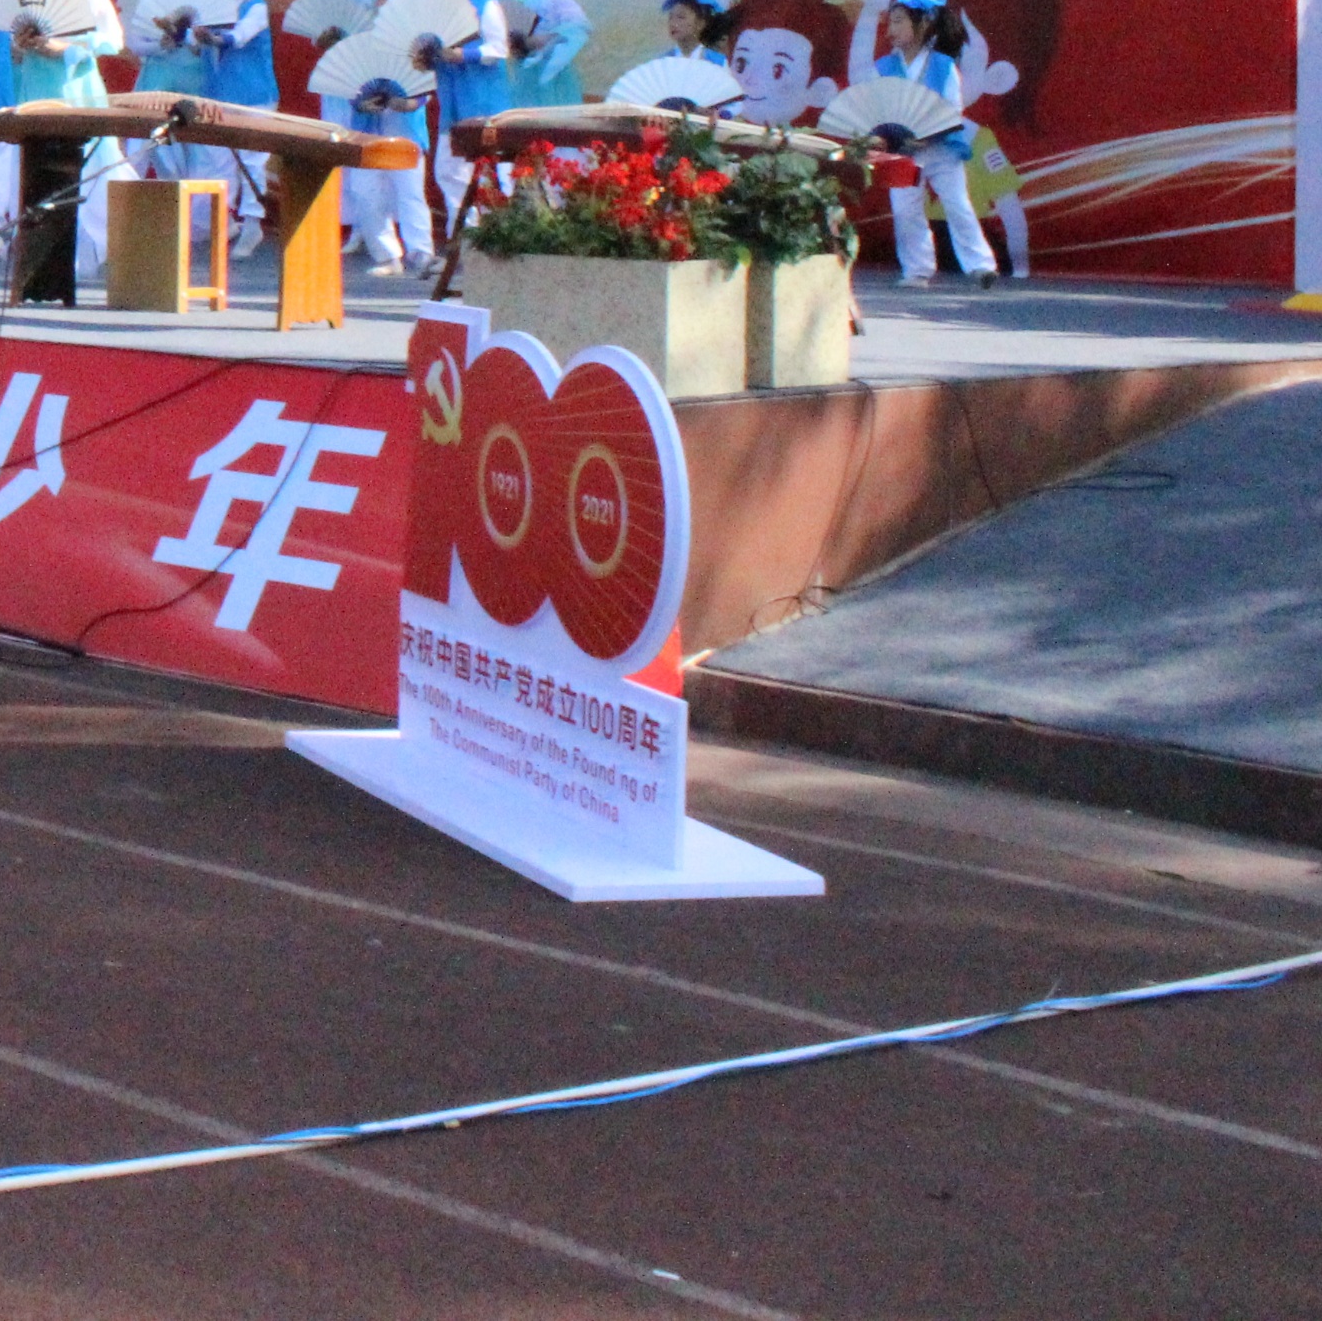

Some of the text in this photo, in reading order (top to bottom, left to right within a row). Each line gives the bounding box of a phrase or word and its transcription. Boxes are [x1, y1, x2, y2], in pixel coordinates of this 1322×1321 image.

[491, 471, 520, 500] 1921
[581, 494, 616, 526] 2021
[399, 672, 659, 804] The 100th Anniversary of the Foundng of
[400, 621, 662, 757] 庆祝中国共产党成立100周年
[429, 716, 620, 824] The Communist Party of China
